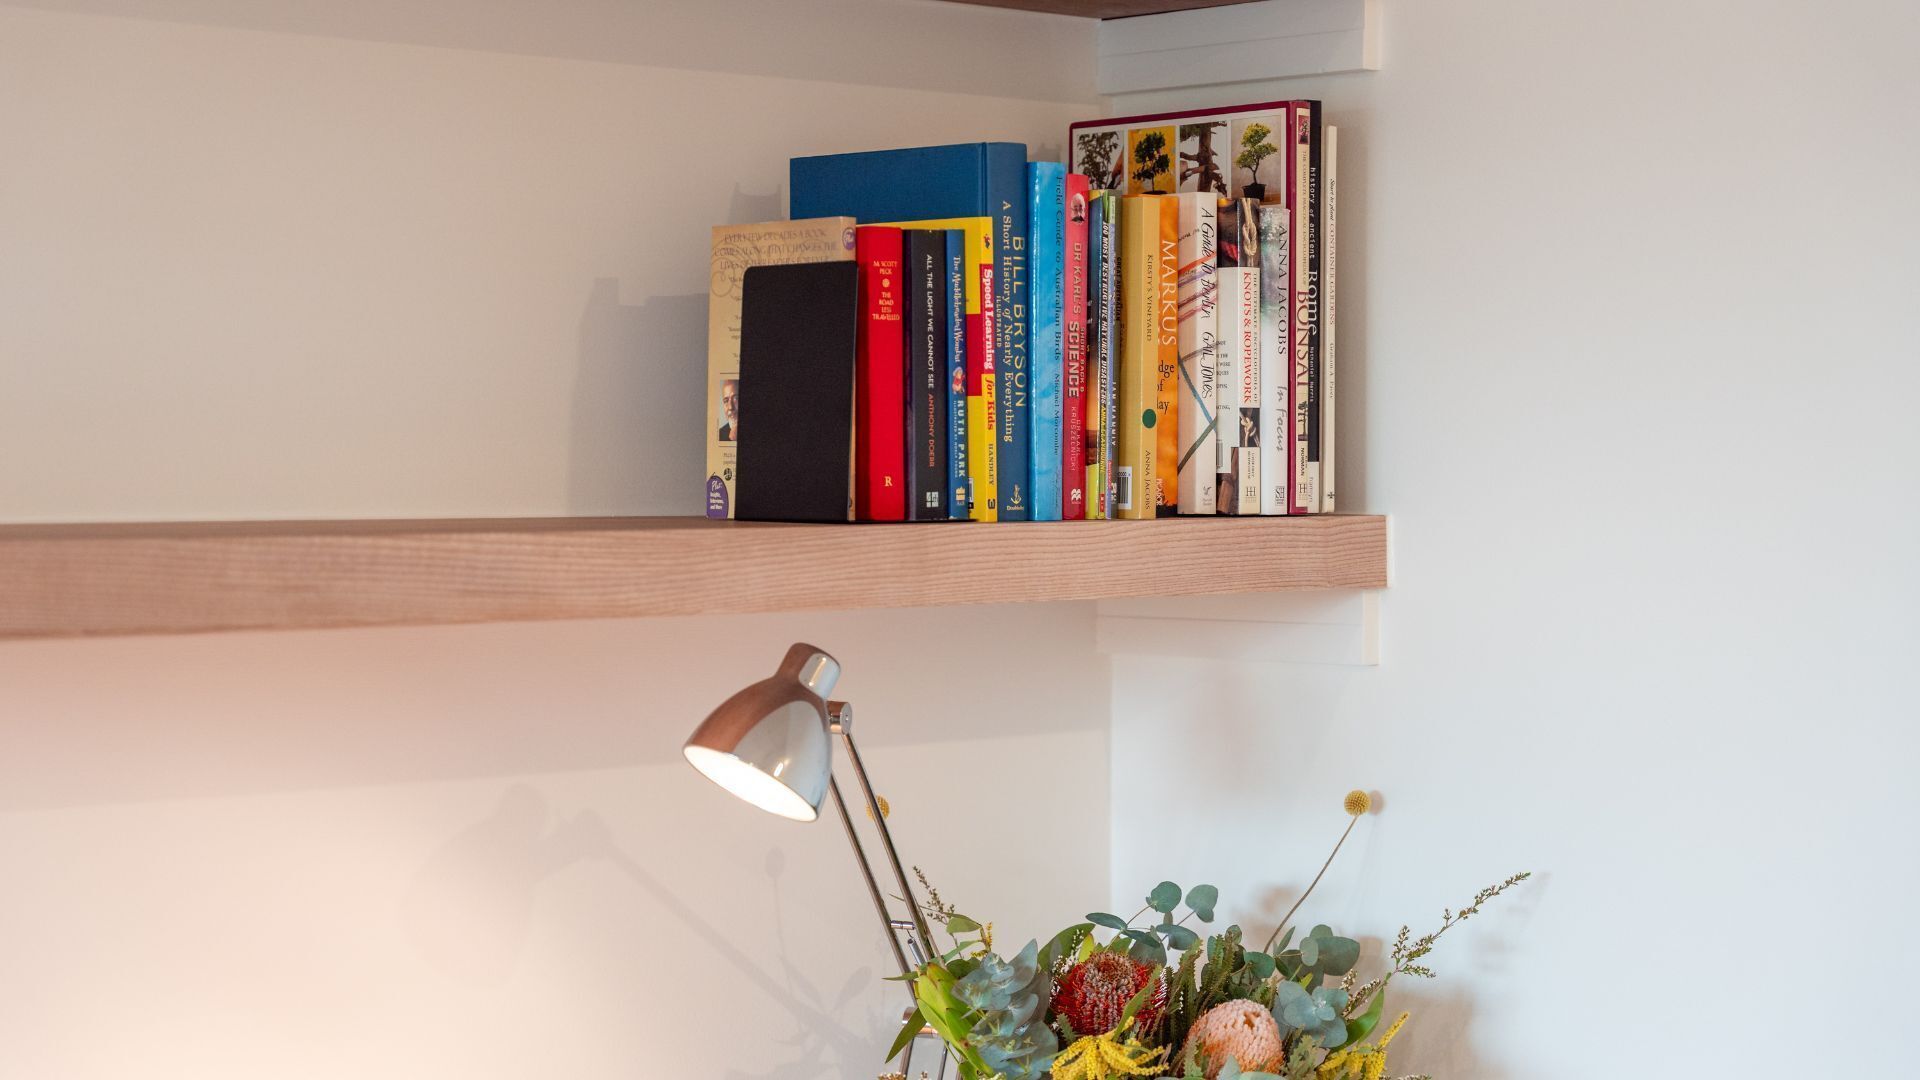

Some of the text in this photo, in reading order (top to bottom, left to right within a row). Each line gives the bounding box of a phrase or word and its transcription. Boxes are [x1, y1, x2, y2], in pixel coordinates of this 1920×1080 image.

[1055, 176, 1063, 205] Field
[1055, 210, 1063, 246] Guide
[1201, 208, 1214, 218] A
[1309, 209, 1314, 217] of
[1055, 251, 1063, 263] to
[1201, 223, 1215, 257] Guide
[953, 255, 961, 271] The
[1073, 242, 1082, 315] DR KARL'S
[1161, 239, 1177, 346] MARKUS
[1201, 278, 1215, 320] Berlin
[1278, 225, 1288, 355] ANNA JACOBS
[1307, 270, 1318, 336] Rome
[927, 318, 933, 332] WE
[1002, 200, 1014, 443] A Short History of Nearly Everything
[1012, 236, 1026, 407] BILL BRYSON
[1243, 272, 1252, 404] KNOTS & ROPEWORK
[1297, 290, 1309, 387] BONSAI
[953, 330, 964, 363] Wombat
[983, 269, 995, 430] Speed Learning for Kids
[1067, 321, 1079, 399] SCIENCE
[957, 400, 965, 436] RUTH
[1276, 386, 1287, 452] In Focus
[884, 476, 893, 487] R
